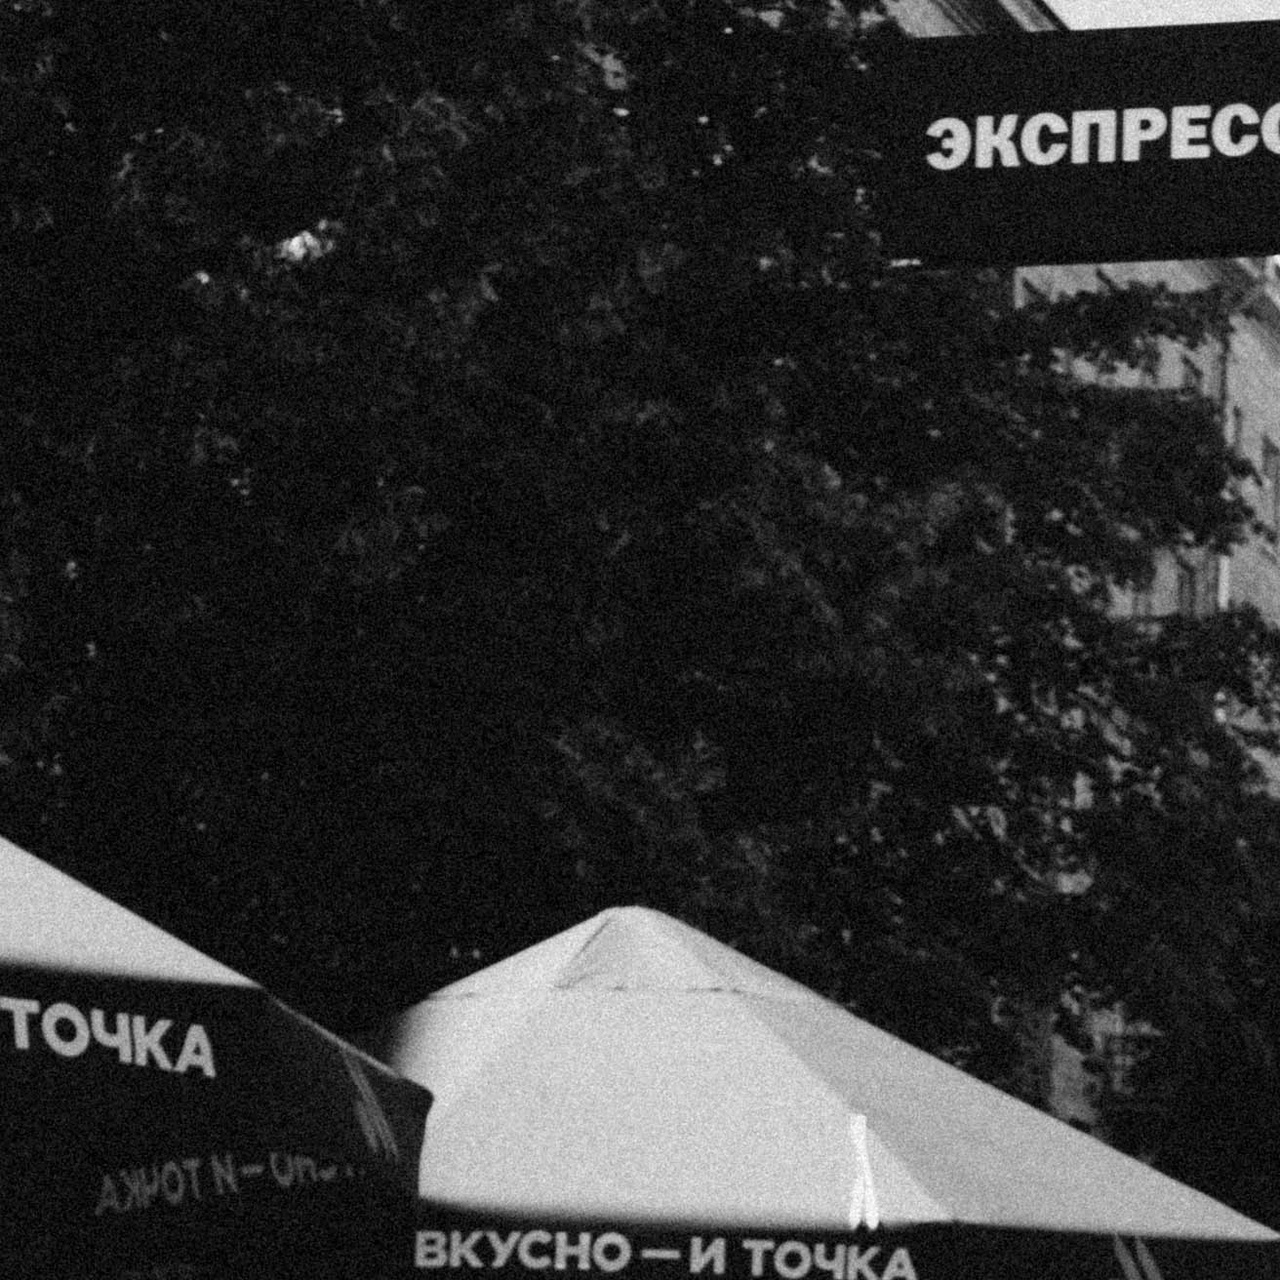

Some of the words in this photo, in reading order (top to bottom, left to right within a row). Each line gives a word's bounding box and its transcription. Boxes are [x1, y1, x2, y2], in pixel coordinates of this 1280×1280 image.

[0, 996, 217, 1078] ТОЧКА
[414, 1230, 632, 1273] ВКУСНО
[689, 1236, 726, 1275] И
